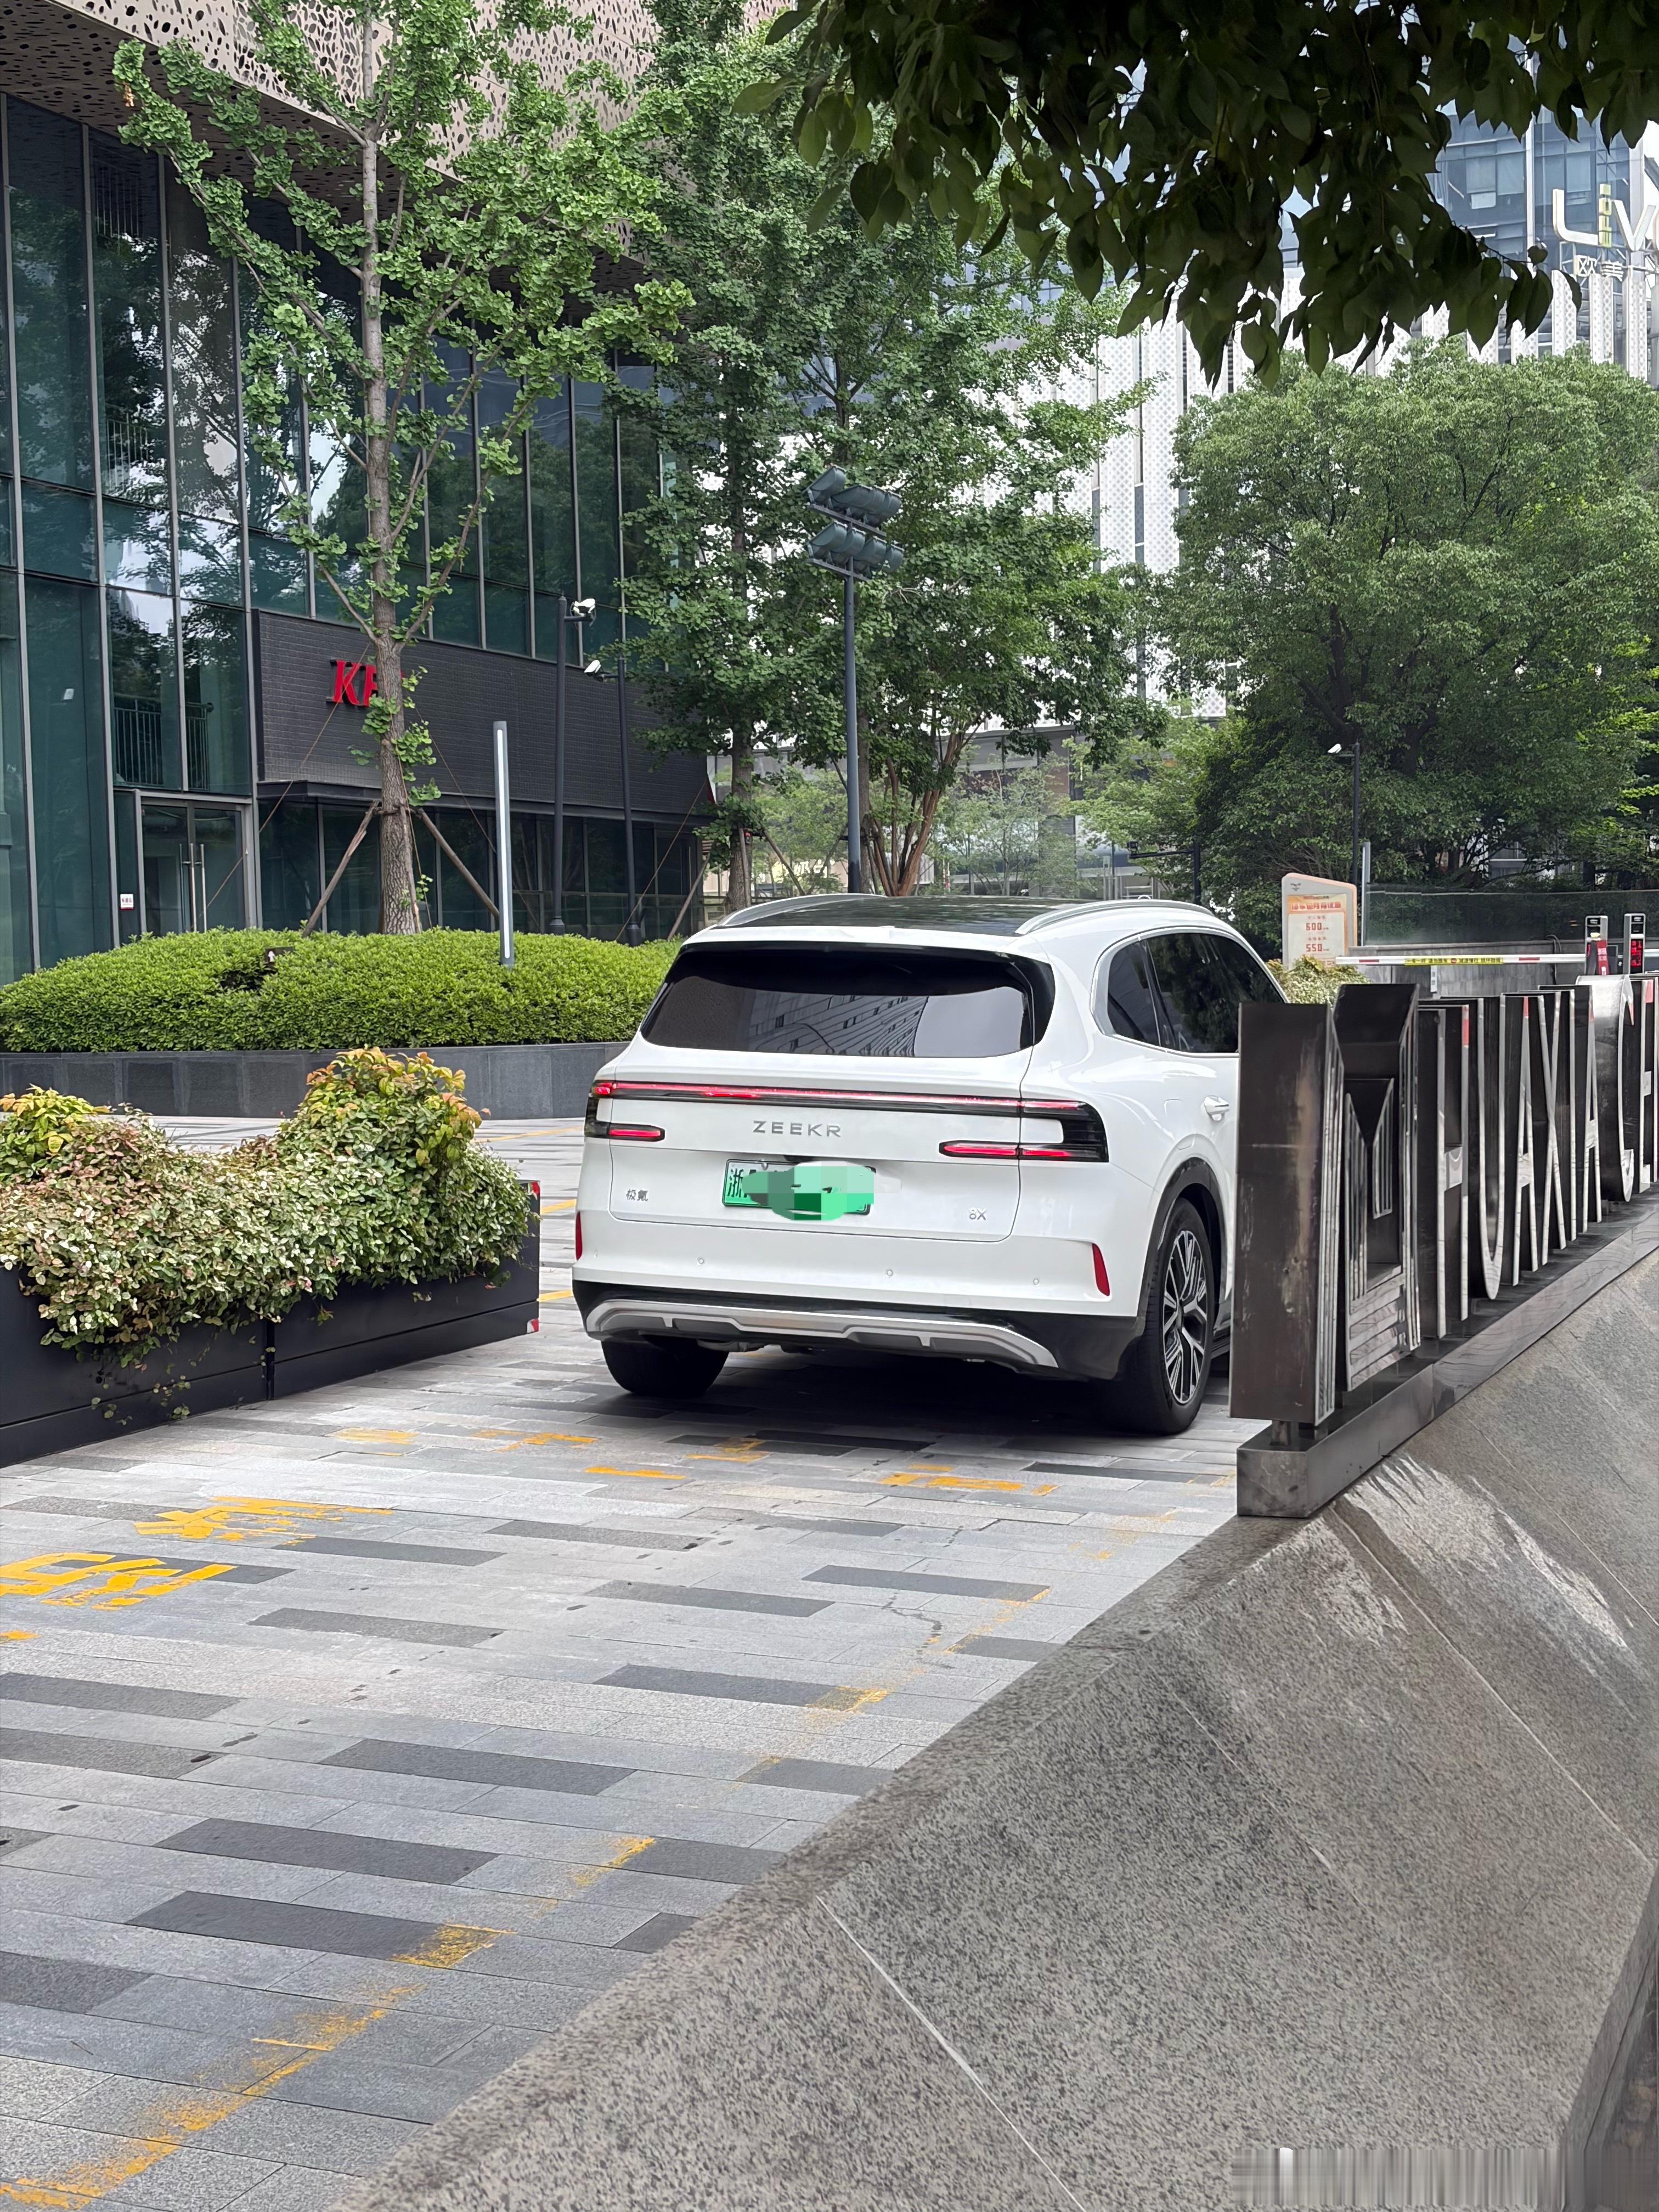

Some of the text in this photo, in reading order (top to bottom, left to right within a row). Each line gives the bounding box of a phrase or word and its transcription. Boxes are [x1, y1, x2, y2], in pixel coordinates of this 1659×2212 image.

[329, 659, 403, 707] KF
[1306, 922, 1322, 931] 600
[1306, 943, 1323, 952] 550
[753, 1120, 842, 1137] ZEEKR
[1435, 985, 1603, 1339] HUAXIA
[626, 1189, 648, 1201] 极氪
[969, 1207, 988, 1221] 8X
